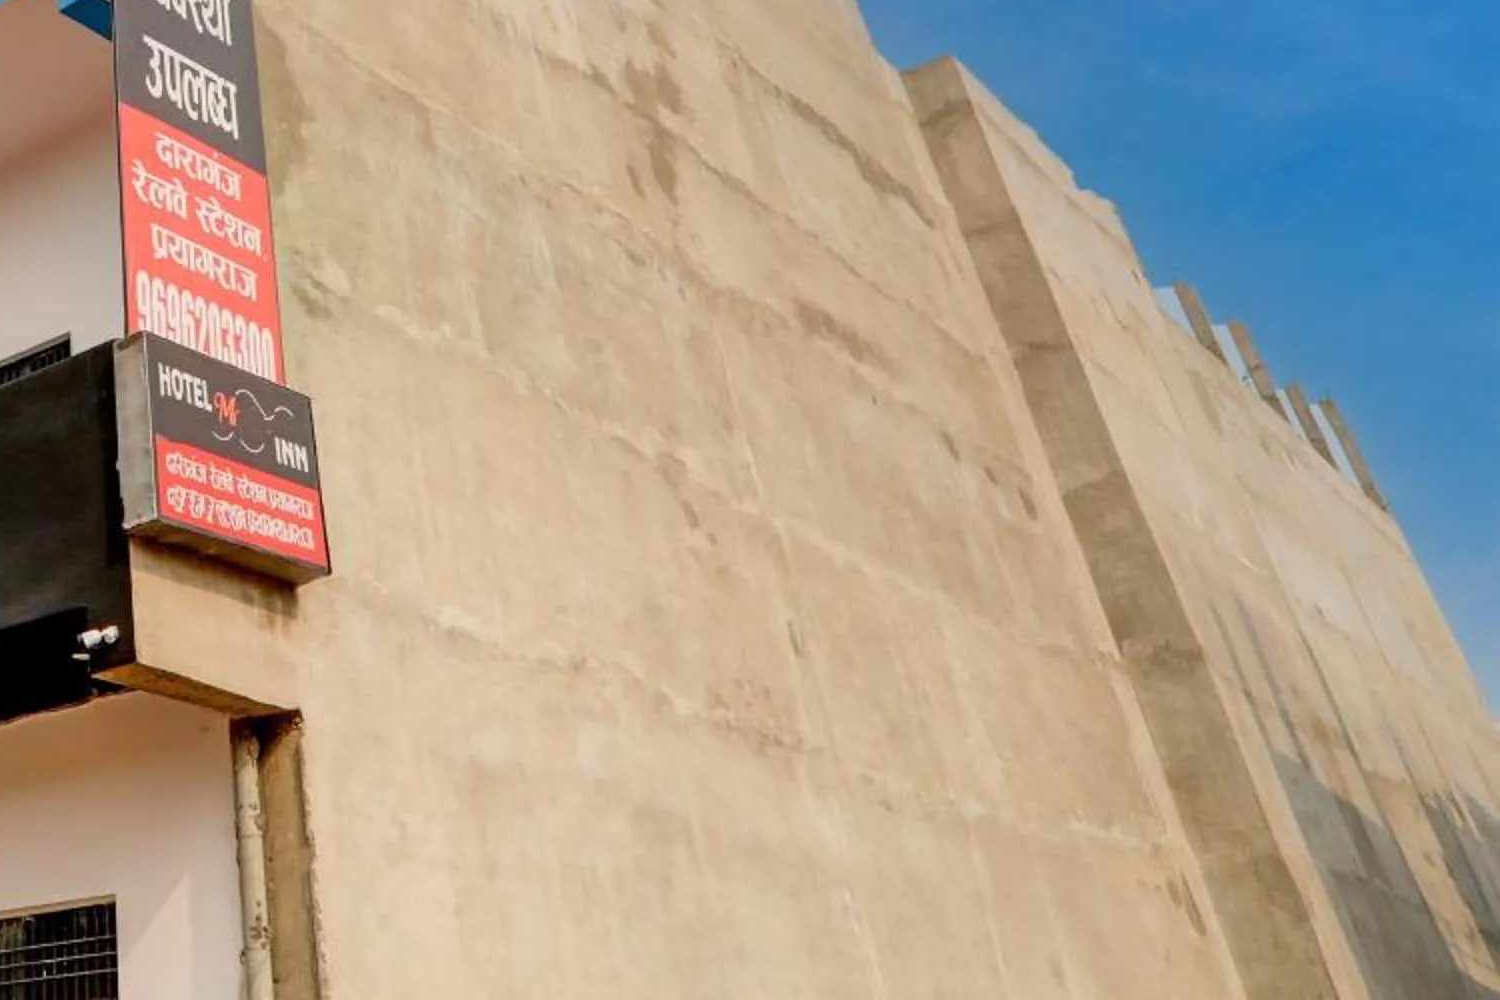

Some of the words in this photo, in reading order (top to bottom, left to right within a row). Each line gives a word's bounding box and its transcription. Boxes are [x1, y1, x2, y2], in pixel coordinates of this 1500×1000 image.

[143, 34, 239, 140] उपलब्ध
[132, 159, 188, 219] रेलवे
[154, 131, 242, 200] दारागंज
[151, 222, 258, 301] प्रयागराज
[136, 269, 277, 382] 9696203300
[158, 362, 213, 412] HOTEL
[274, 436, 309, 473] INN
